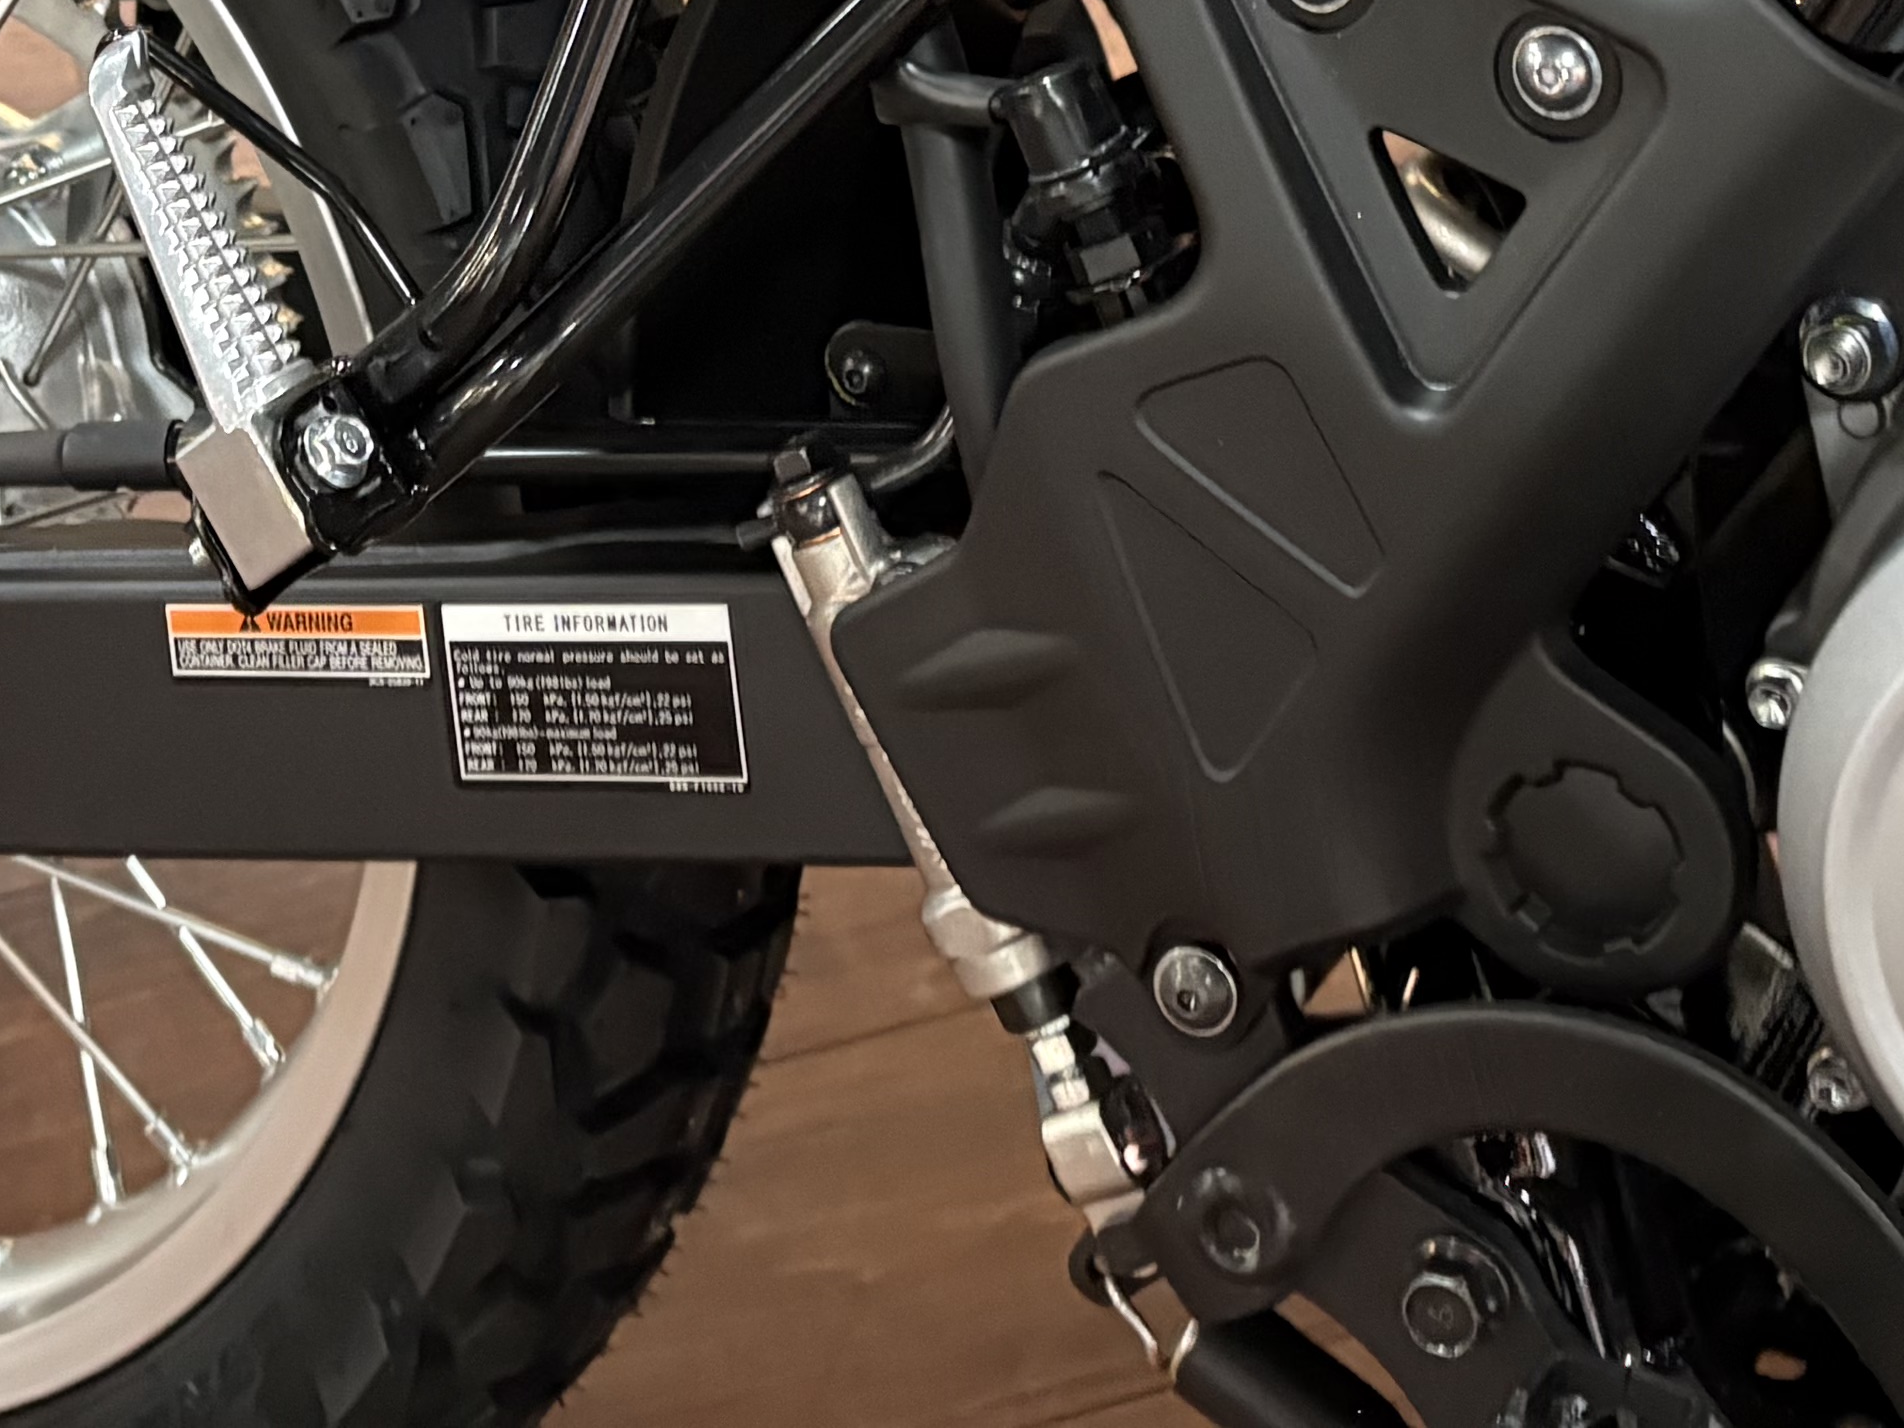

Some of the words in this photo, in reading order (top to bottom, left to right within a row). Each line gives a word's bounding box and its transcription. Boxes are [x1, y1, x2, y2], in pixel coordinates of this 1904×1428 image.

[267, 612, 354, 632] WARNING
[503, 613, 545, 633] TIRE
[553, 613, 669, 633] INFORMATION
[319, 640, 348, 655] FROM
[359, 640, 398, 656] SEALED
[453, 647, 479, 663] Cold
[486, 647, 512, 663] tire
[517, 647, 556, 663] normal
[562, 648, 614, 665] pressure
[620, 647, 659, 664] should
[664, 647, 679, 664] be
[685, 648, 705, 664] set
[711, 649, 726, 664] as
